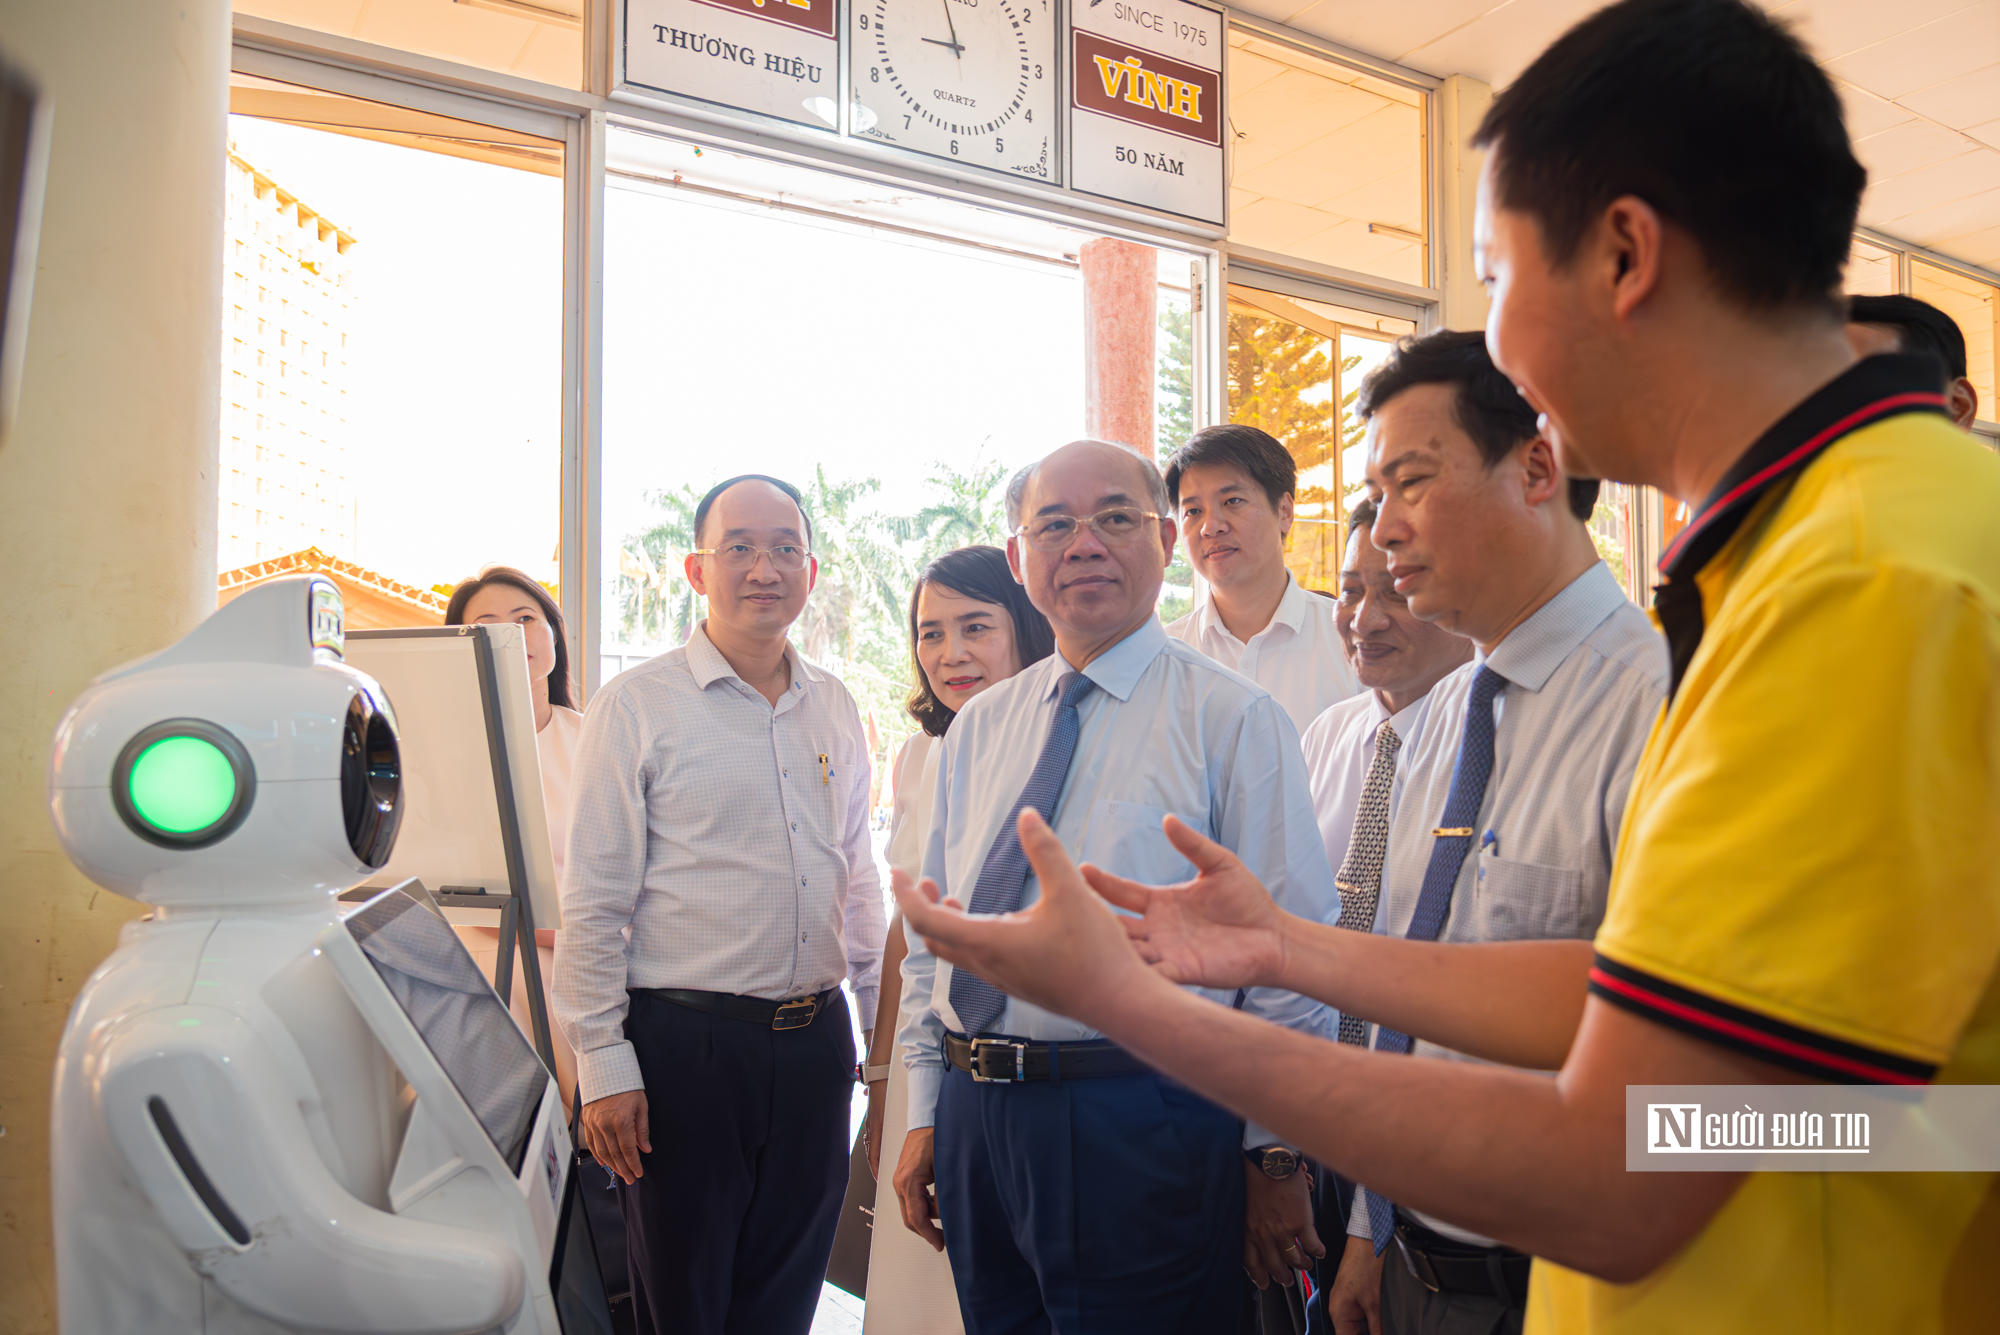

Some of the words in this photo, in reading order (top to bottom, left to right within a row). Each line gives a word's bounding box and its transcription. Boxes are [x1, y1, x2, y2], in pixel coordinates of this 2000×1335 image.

[860, 14, 868, 30] 9
[1023, 8, 1031, 23] 2
[1114, 2, 1163, 33] SINCE
[1173, 21, 1207, 46] 1975
[653, 24, 756, 66] THƯƠNG
[764, 53, 822, 83] HIỆU
[870, 67, 879, 83] 8
[1034, 64, 1043, 80] 3
[1093, 54, 1202, 123] VĨNH
[933, 89, 976, 108] QUARTZ
[903, 114, 911, 130] 7
[1024, 109, 1033, 123] 4
[950, 139, 959, 155] 6
[995, 137, 1004, 153] 5
[1115, 146, 1137, 164] 50
[1144, 152, 1184, 176] NĂM
